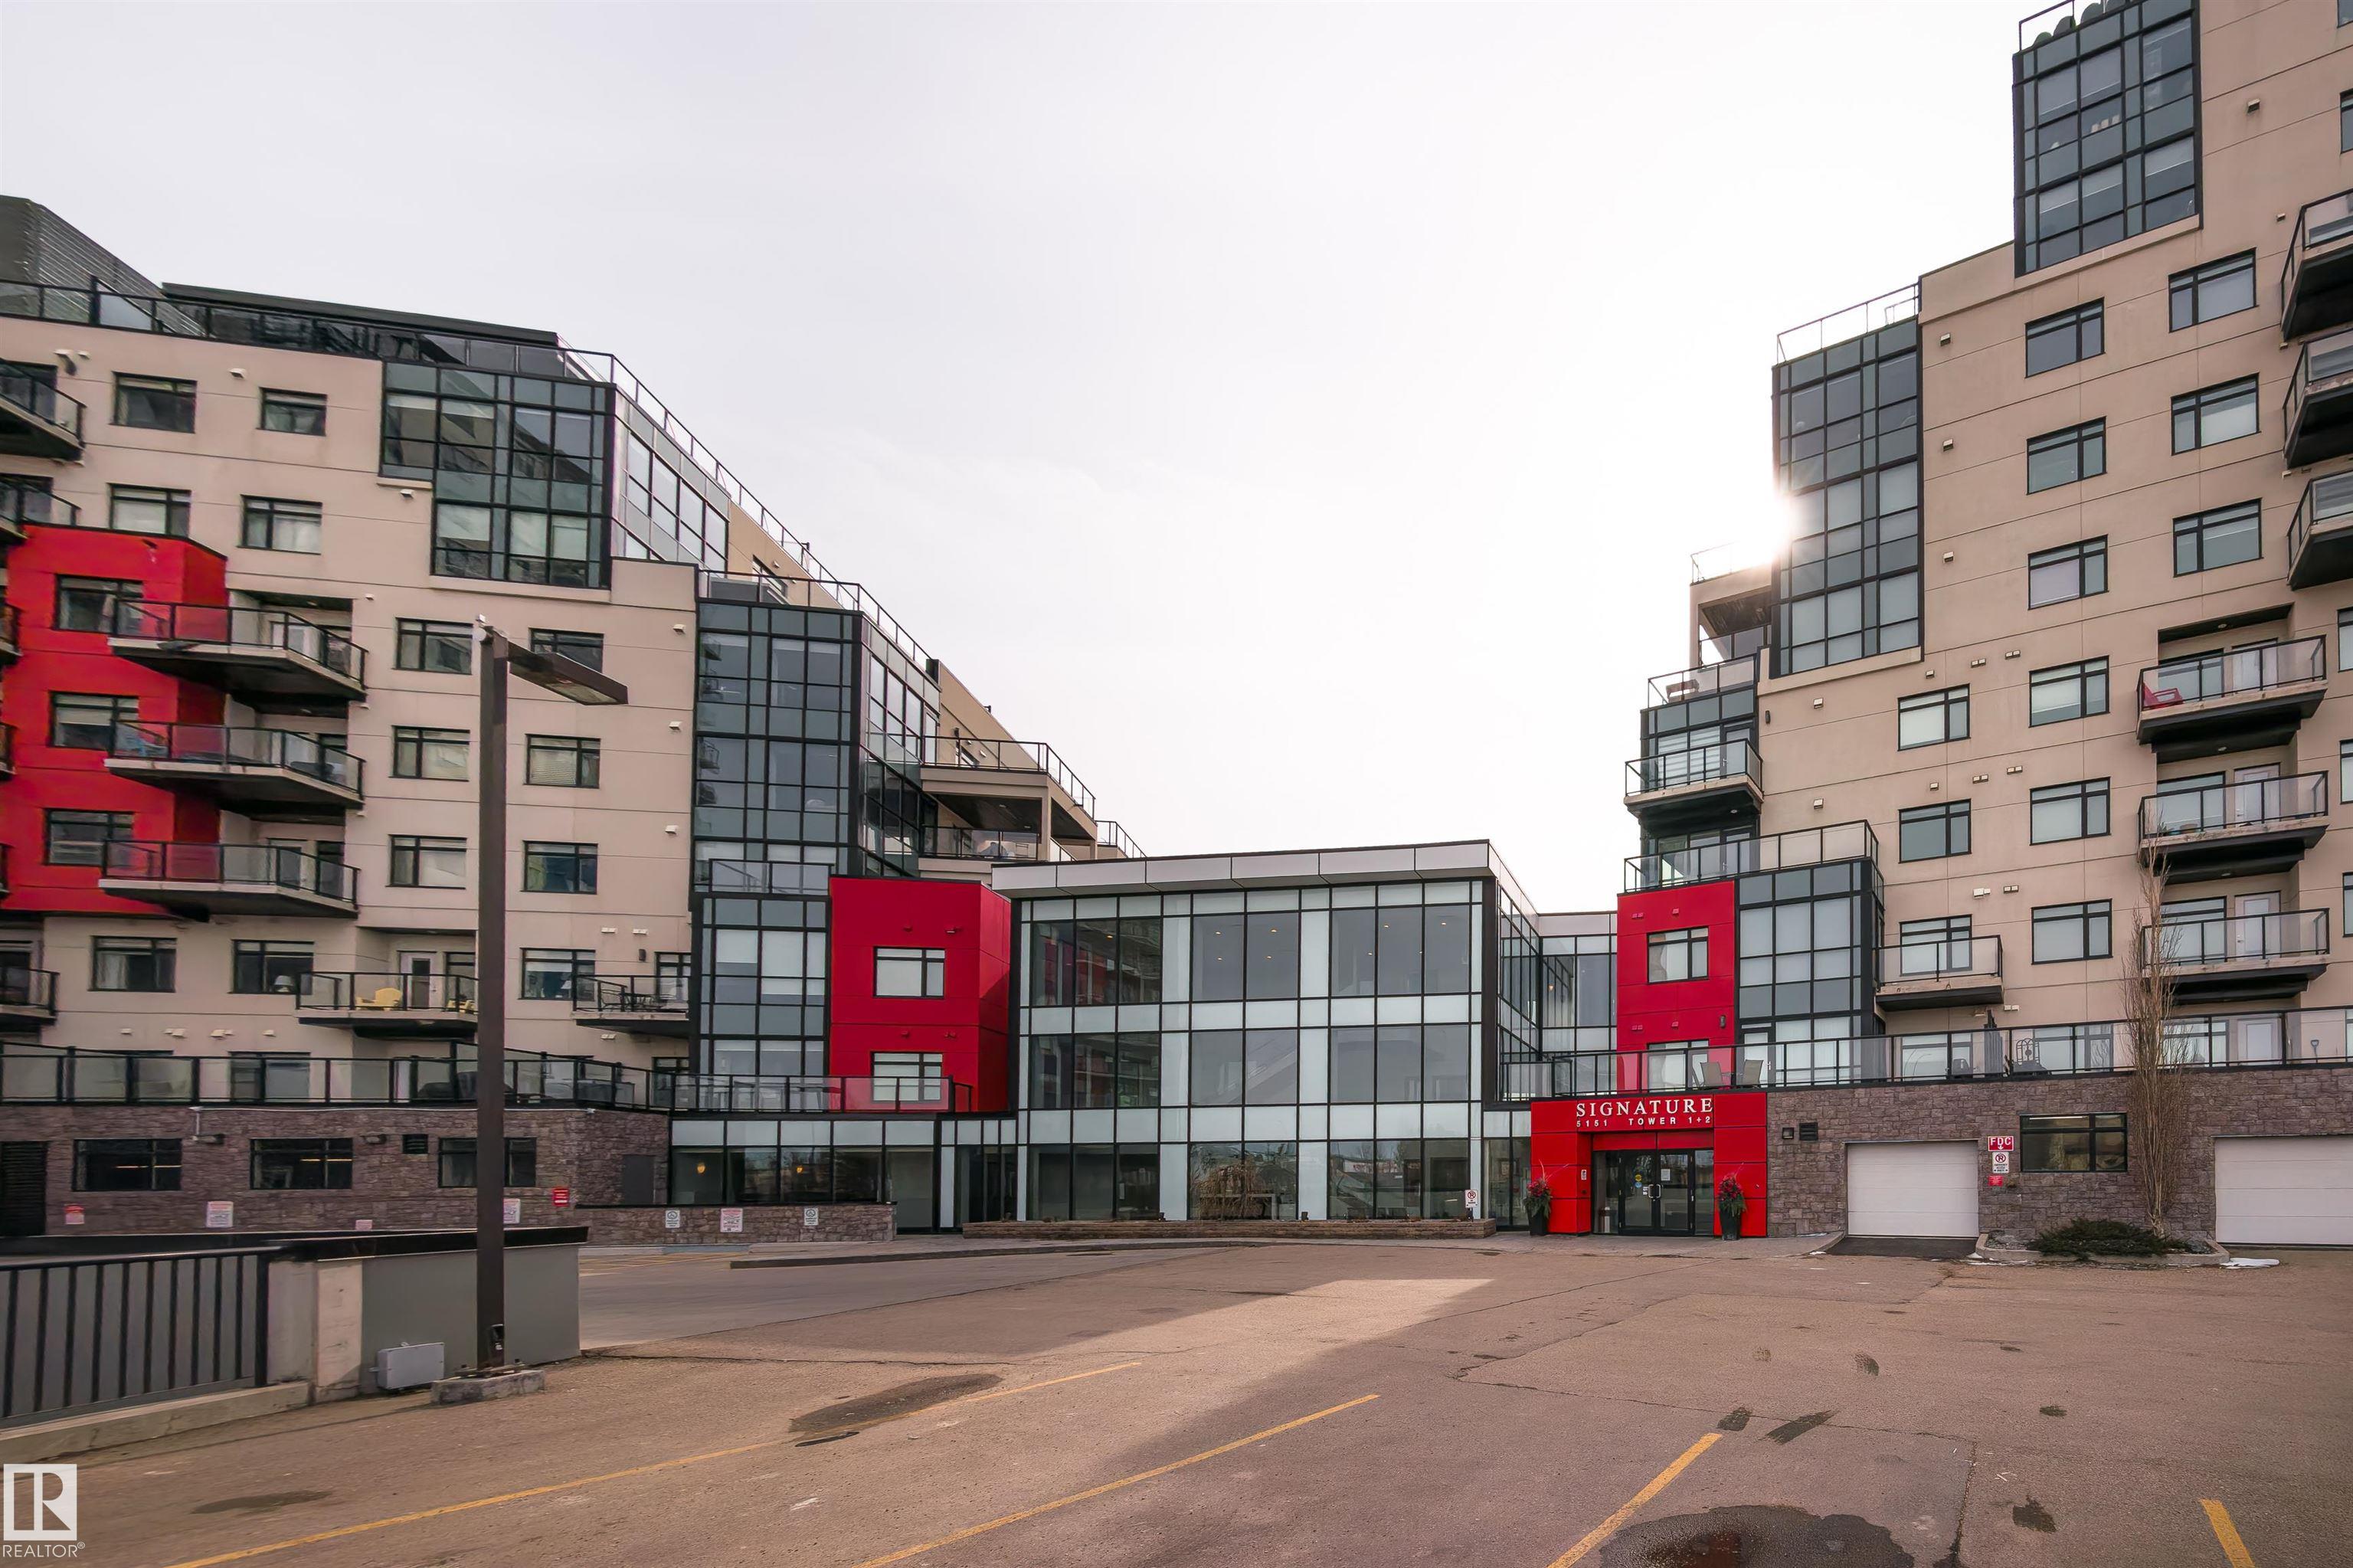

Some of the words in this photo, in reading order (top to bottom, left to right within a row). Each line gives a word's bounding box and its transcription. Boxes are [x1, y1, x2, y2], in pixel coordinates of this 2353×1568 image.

[1576, 1098, 1713, 1117] SIGNATURE
[1576, 1119, 1608, 1128] 5151
[1628, 1117, 1677, 1126] TOWER
[1991, 1137, 2011, 1145] FDC
